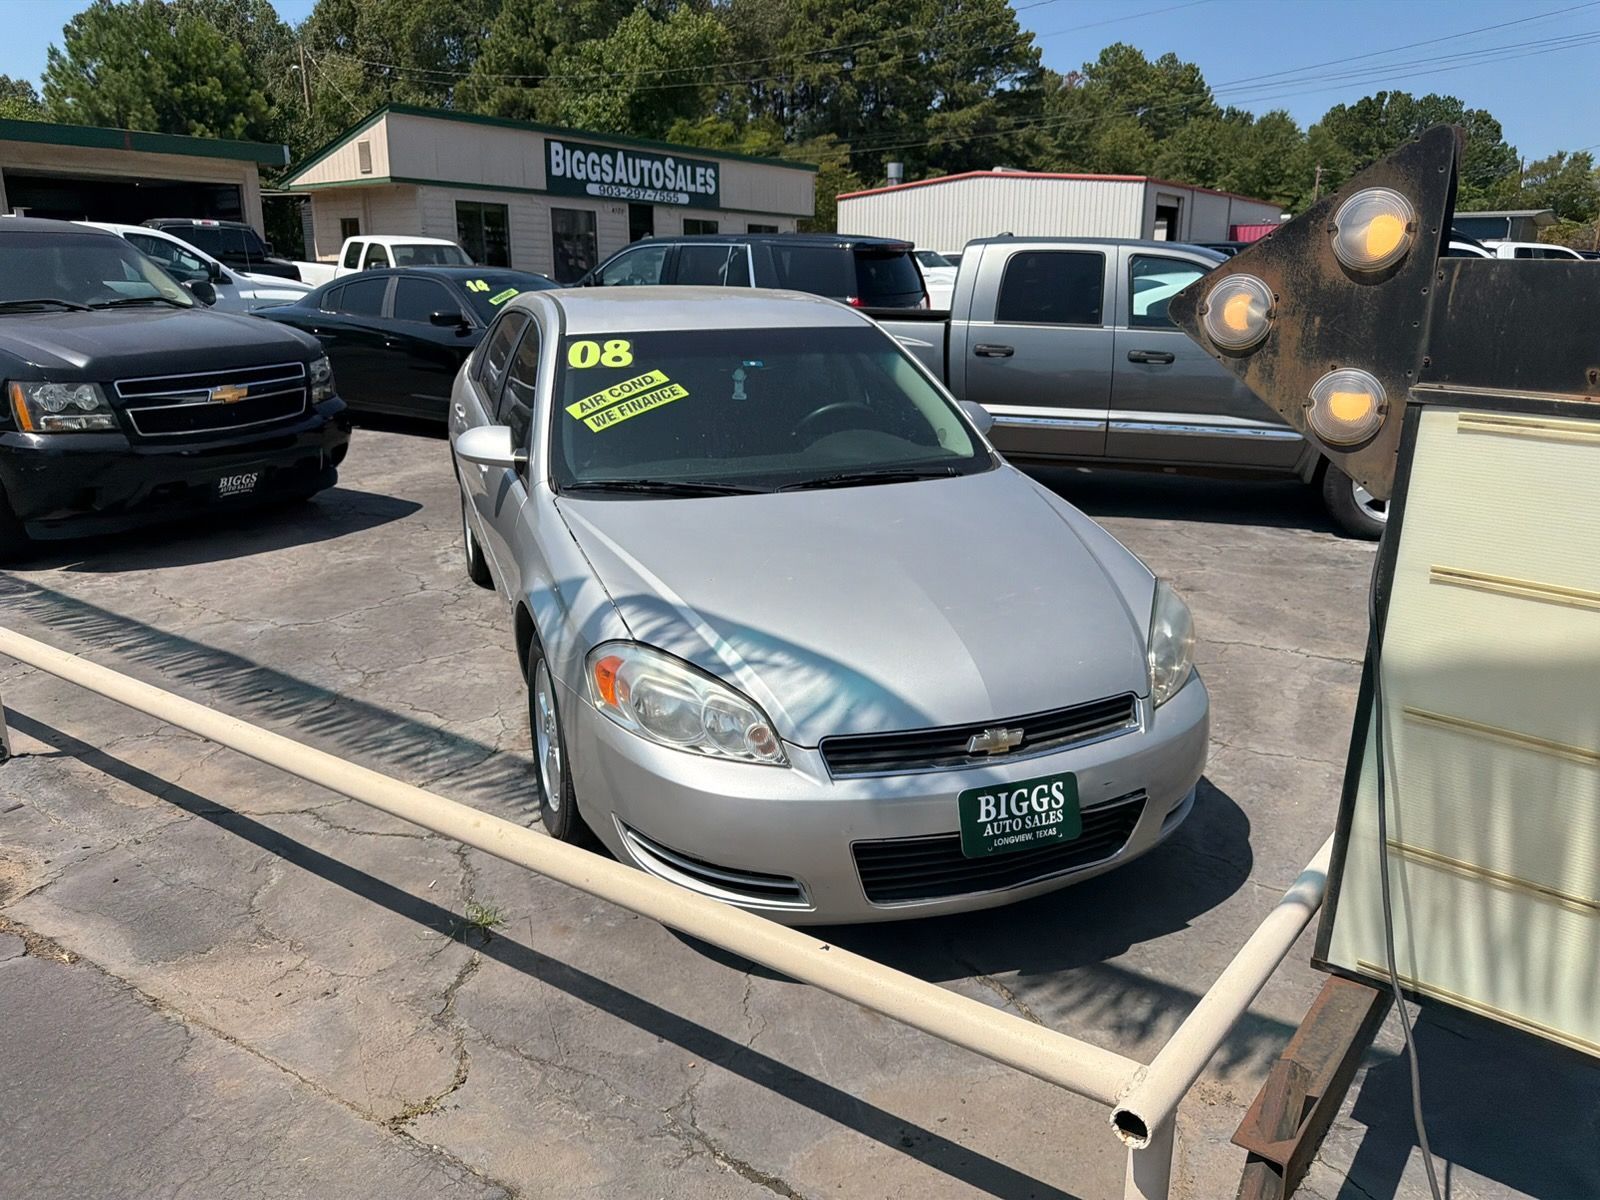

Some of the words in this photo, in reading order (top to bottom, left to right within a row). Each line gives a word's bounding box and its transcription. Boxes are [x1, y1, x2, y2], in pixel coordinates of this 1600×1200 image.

[598, 184, 679, 203] 903-297-7555
[567, 339, 633, 368] 08
[578, 394, 607, 413] AIR
[608, 375, 661, 398] COND.
[591, 407, 618, 428] WE
[619, 385, 681, 417] FINANCE
[218, 472, 258, 488] BIGGS
[977, 781, 1065, 823] BIGGS
[983, 818, 1022, 837] AUTO
[1025, 808, 1064, 829] SALES
[993, 832, 1034, 847] LONGVIEW,
[1036, 827, 1057, 838] TEXAS
